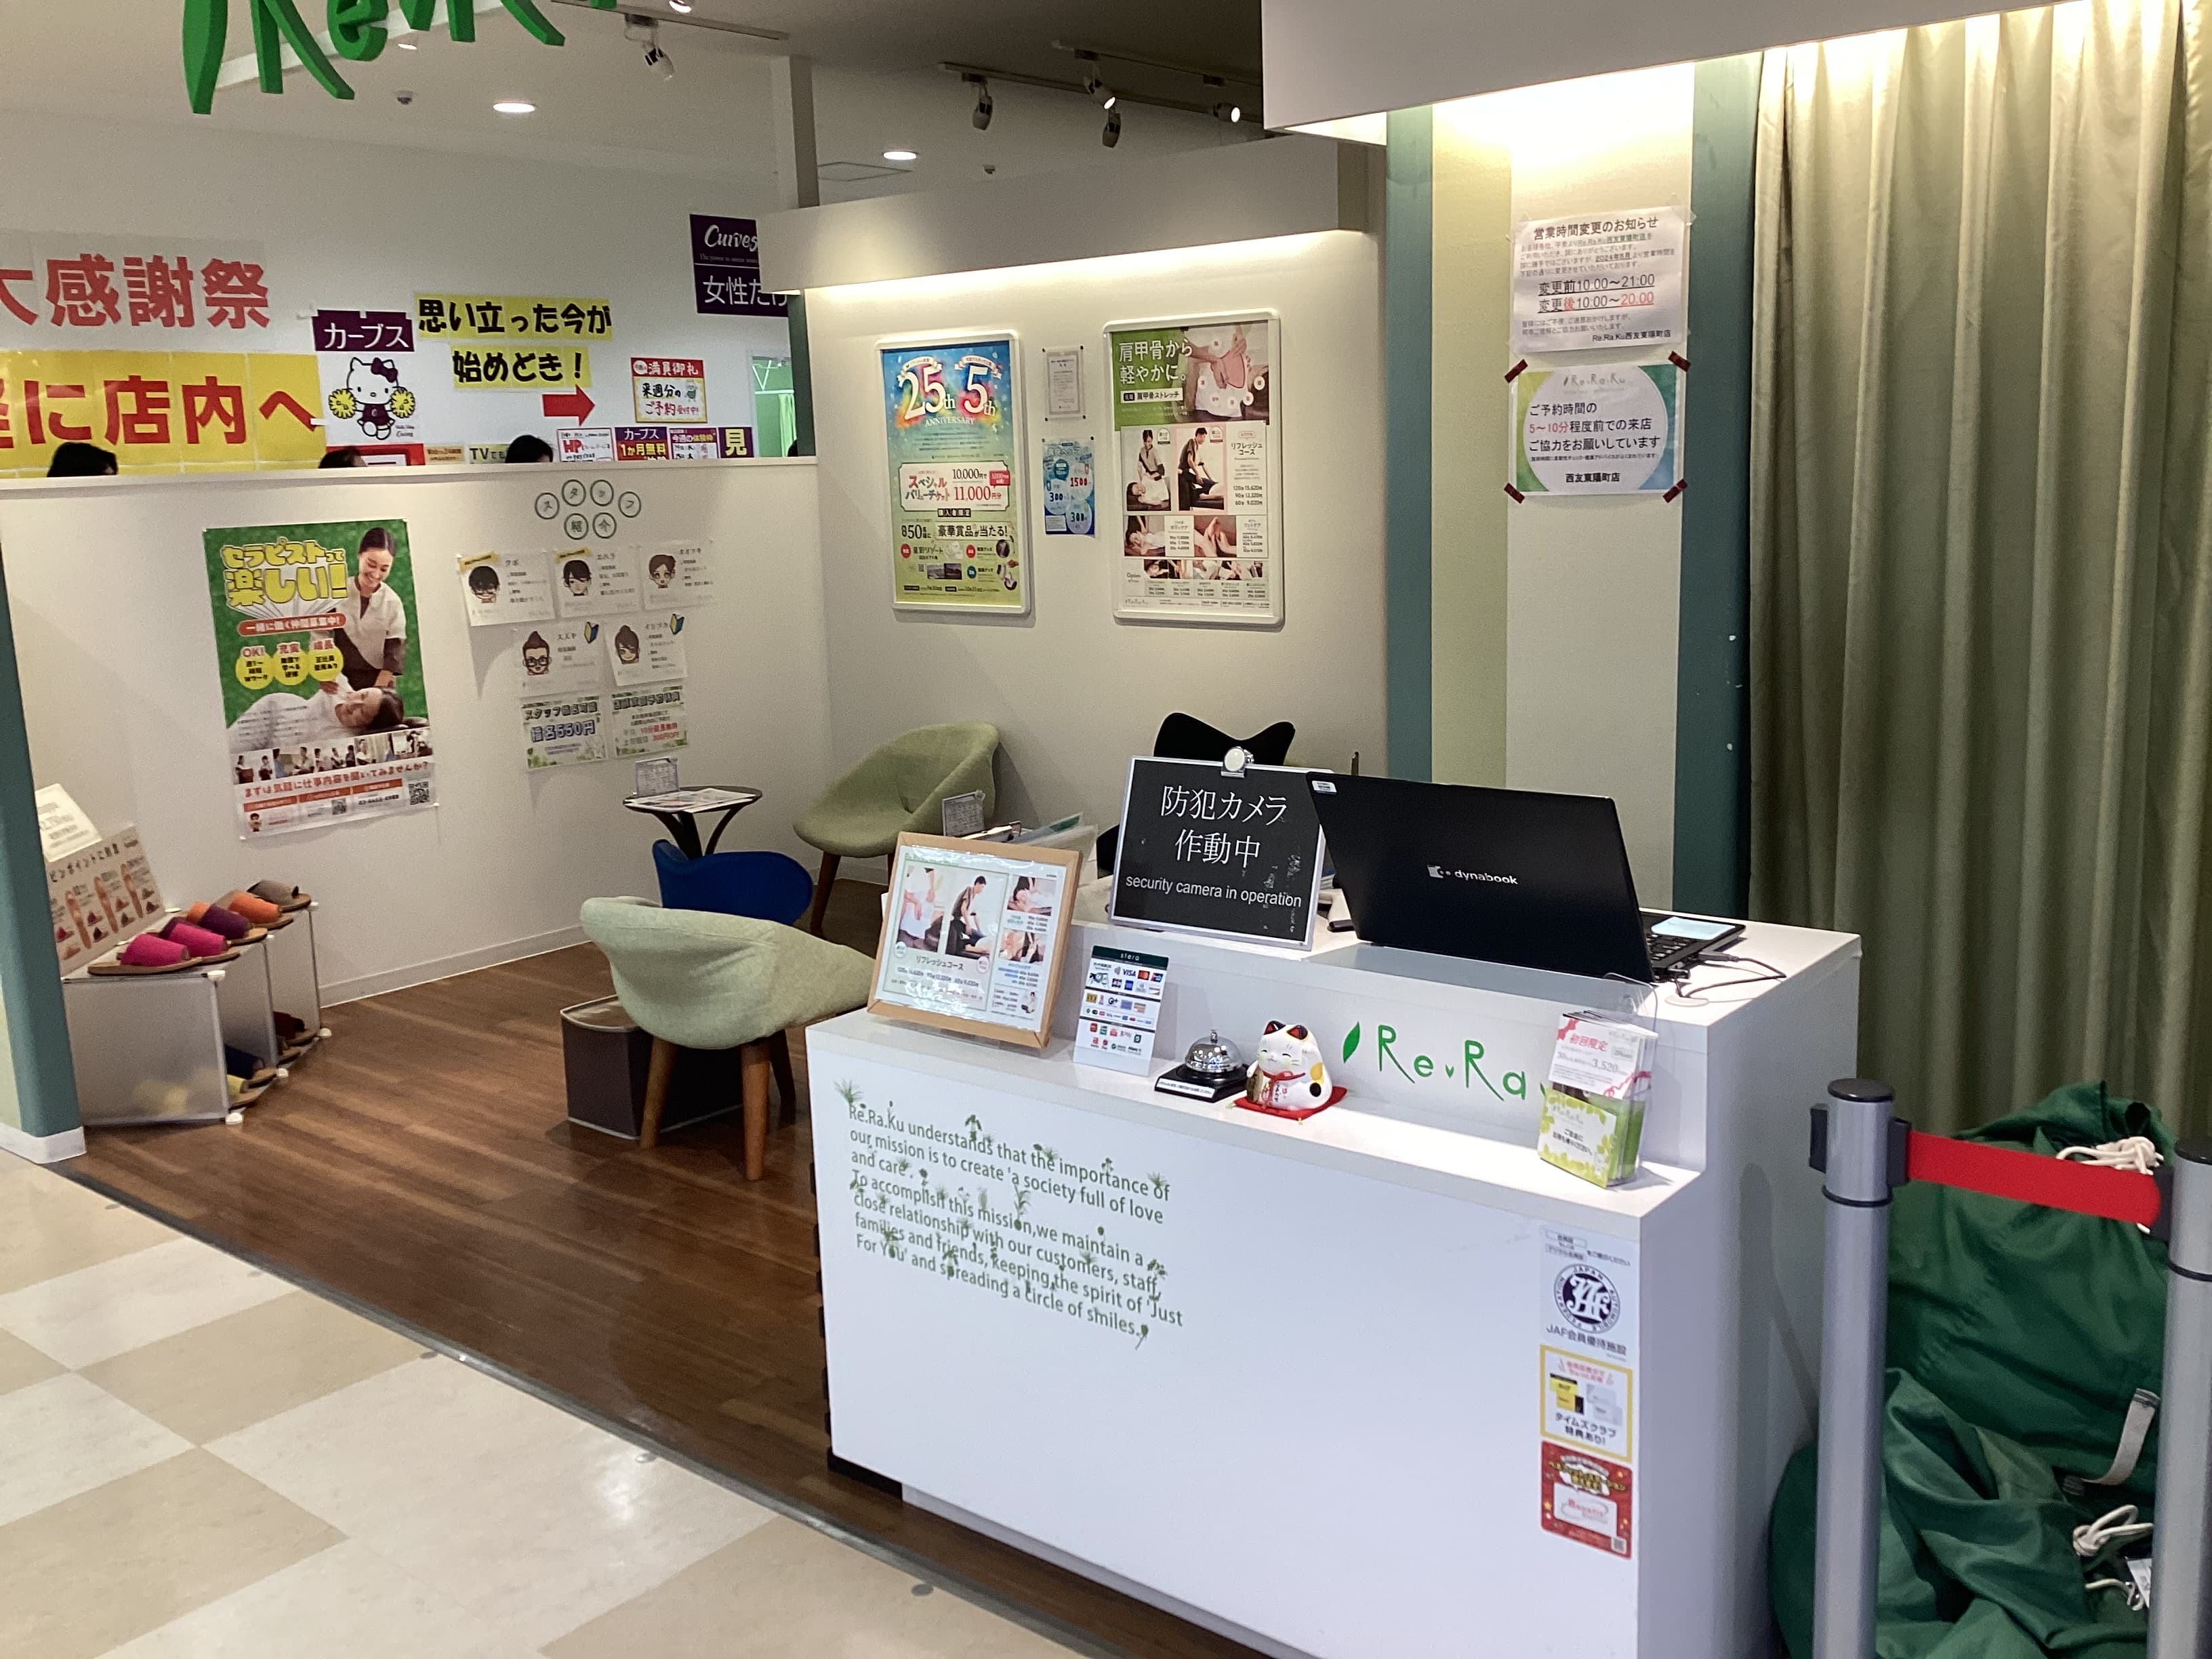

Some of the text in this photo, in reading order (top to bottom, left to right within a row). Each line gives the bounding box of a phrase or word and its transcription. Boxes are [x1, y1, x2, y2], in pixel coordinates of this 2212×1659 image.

[704, 224, 758, 251] Curves
[1534, 216, 1660, 241] 営業時間変更のお知らせ
[419, 299, 613, 334] 思い立った今が
[324, 323, 409, 349] カーブス
[1119, 338, 1193, 363] 肩甲骨から
[648, 361, 699, 375] 満員御礼
[642, 382, 681, 398] 来週分の
[899, 365, 956, 420] 25th
[964, 365, 996, 417] 5th
[1136, 391, 1180, 401] 肩甲骨ストレッチ
[0, 375, 318, 449] に店内へ
[1530, 401, 1597, 417] ご予約時間の
[925, 416, 976, 427] ANNIVERSARY
[623, 428, 659, 440] カーブス
[725, 429, 747, 455] 見
[1231, 442, 1263, 451] リフレッシュ
[1529, 436, 1661, 452] ご協力をお願いしています
[908, 476, 947, 489] スペシャル
[1070, 477, 1088, 487] 1500
[1565, 472, 1620, 483] 西友東陽町店
[905, 489, 950, 501] バリューチケット
[1049, 492, 1063, 501] 300
[1071, 512, 1084, 522] 300
[222, 537, 346, 569] セラピストって
[531, 719, 595, 743] 指名550円
[1160, 784, 1288, 826] 防犯カメラ
[1174, 828, 1261, 869] 作動中
[1454, 867, 1519, 886] dynabook
[1126, 875, 1302, 908] security camera in operation
[916, 955, 964, 970] リフレッシュコース
[1120, 952, 1140, 962] stera
[1123, 968, 1136, 977] VISA
[851, 1151, 875, 1168] and
[908, 1124, 993, 1155] understands
[997, 1143, 1027, 1165] that
[1031, 1151, 1055, 1172] the
[1059, 1158, 1149, 1196] importance
[1153, 1184, 1170, 1202] of
[850, 1130, 872, 1145] our
[876, 1135, 924, 1160] mission
[928, 1146, 939, 1164] is
[943, 1154, 957, 1168] to
[960, 1158, 1004, 1181] create
[1024, 1175, 1076, 1204] society
[1080, 1186, 1105, 1208] full
[1109, 1197, 1126, 1214] of
[1130, 1198, 1164, 1225] love
[851, 1169, 868, 1187] To
[872, 1177, 945, 1210] accomplish
[949, 1195, 974, 1218] this
[1063, 1231, 1130, 1263] maintain
[1135, 1252, 1143, 1267] a
[854, 1193, 886, 1214] close
[890, 1204, 969, 1241] relationship
[973, 1228, 1004, 1250] with
[1008, 1239, 1032, 1257] our
[855, 1211, 905, 1242] families
[908, 1231, 933, 1250] and
[1082, 1284, 1122, 1308] spirit
[1127, 1295, 1143, 1314] of
[1573, 1265, 1605, 1282] JAPAN
[857, 1233, 877, 1254] For
[912, 1254, 936, 1272] and
[940, 1261, 1008, 1298] spreading
[1012, 1286, 1021, 1298] a
[1025, 1286, 1064, 1313] circle
[1068, 1301, 1083, 1318] of
[1087, 1307, 1140, 1336] smiles.
